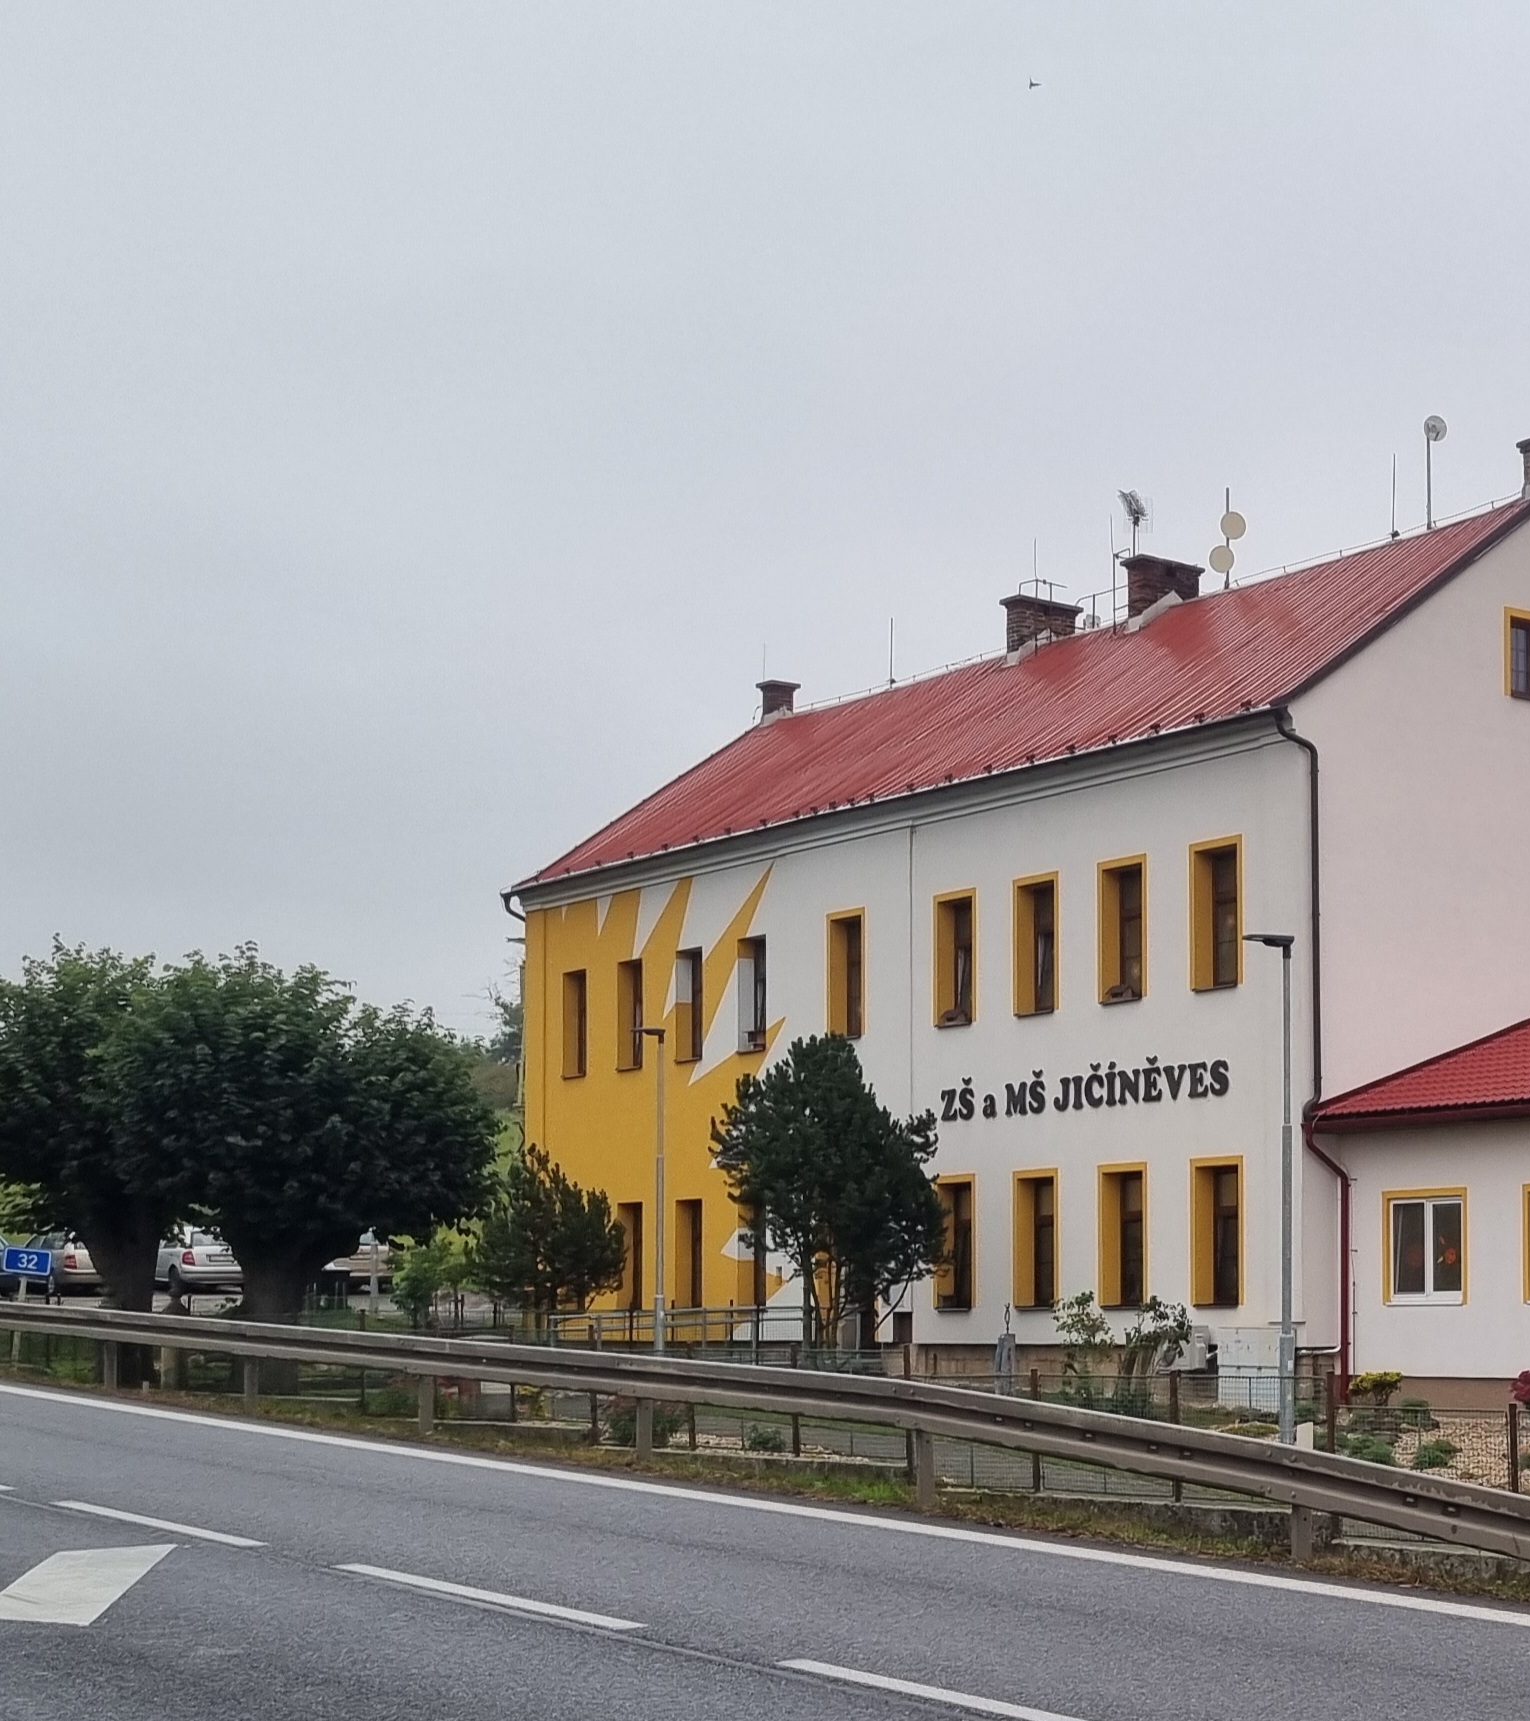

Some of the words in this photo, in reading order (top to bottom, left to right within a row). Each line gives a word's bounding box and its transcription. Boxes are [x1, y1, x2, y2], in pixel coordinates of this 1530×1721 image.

[941, 1076, 975, 1121] ZŠ
[982, 1094, 997, 1119] a
[1004, 1069, 1046, 1116] MŠ
[1053, 1055, 1230, 1112] JIČÍNĚVES
[18, 1253, 38, 1270] 32
